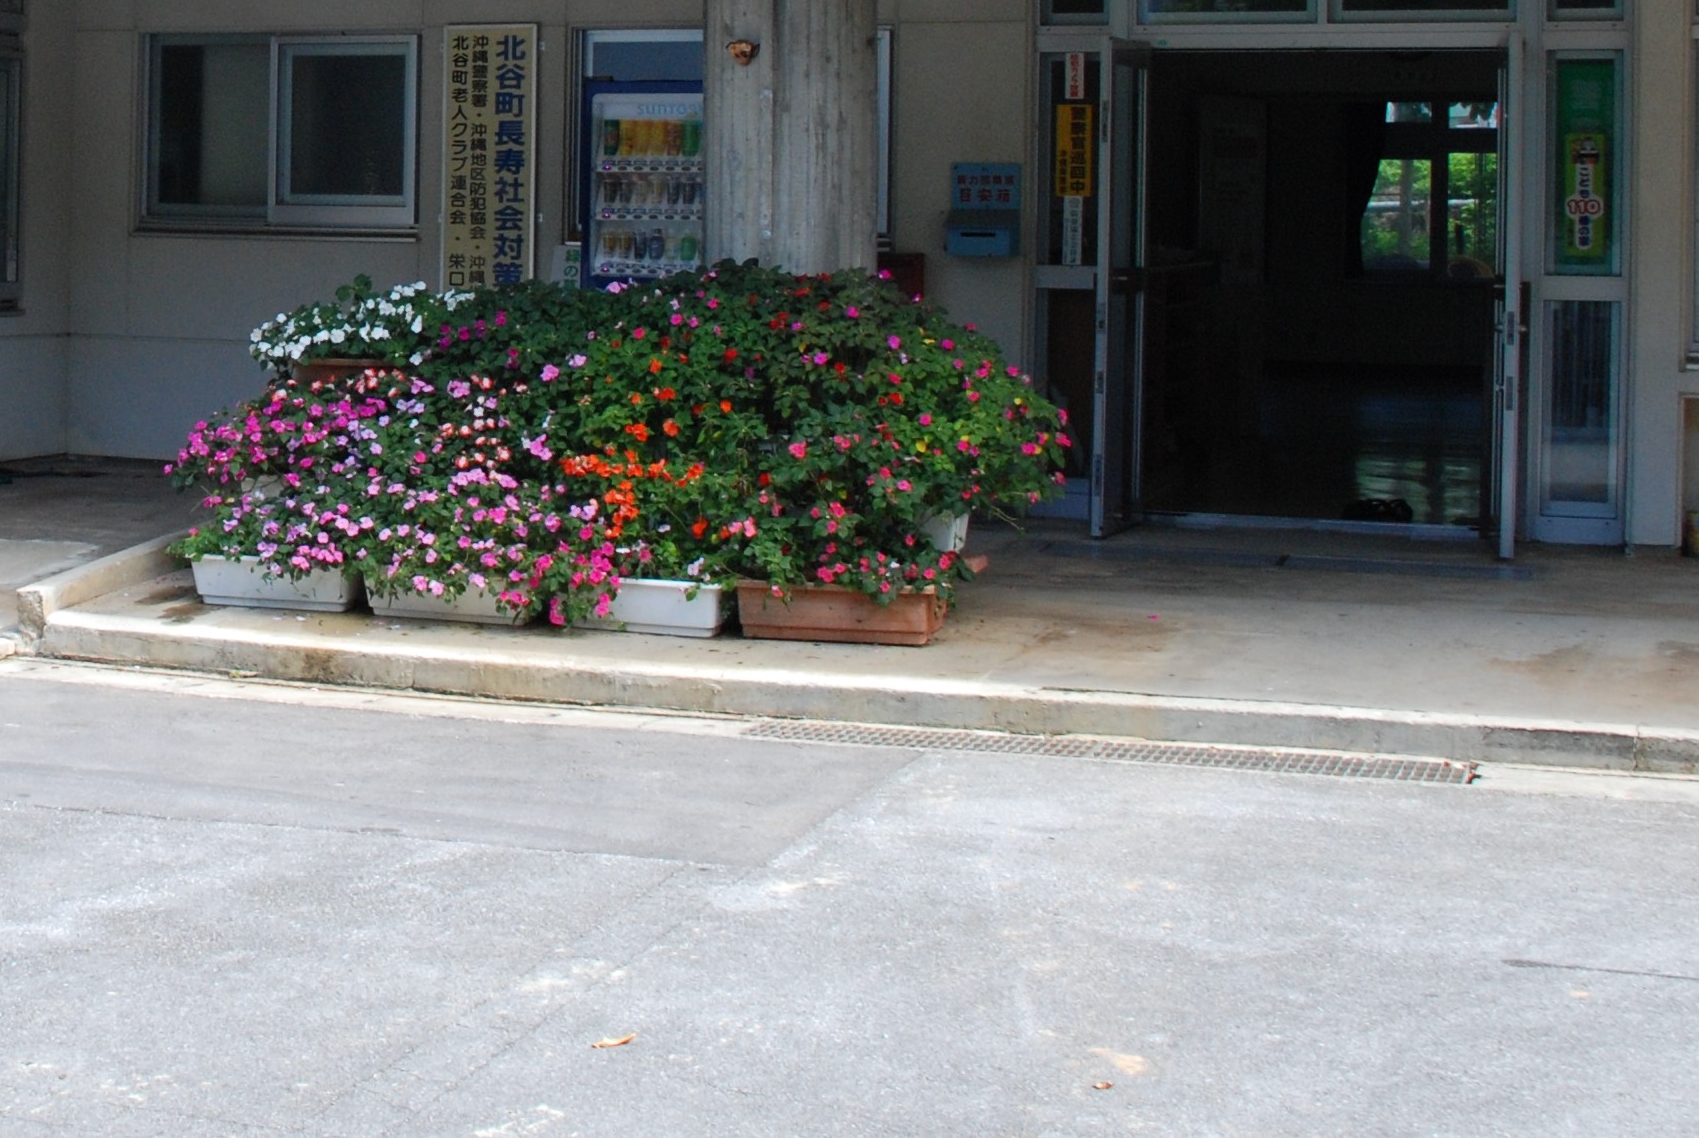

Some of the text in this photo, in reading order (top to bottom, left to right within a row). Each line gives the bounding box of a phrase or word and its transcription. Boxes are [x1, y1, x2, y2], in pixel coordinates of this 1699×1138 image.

[468, 36, 489, 289] 沖縄警察署・沖縄地区防犯協会・沖縄
[491, 35, 526, 287] 北谷町長寿社会対策
